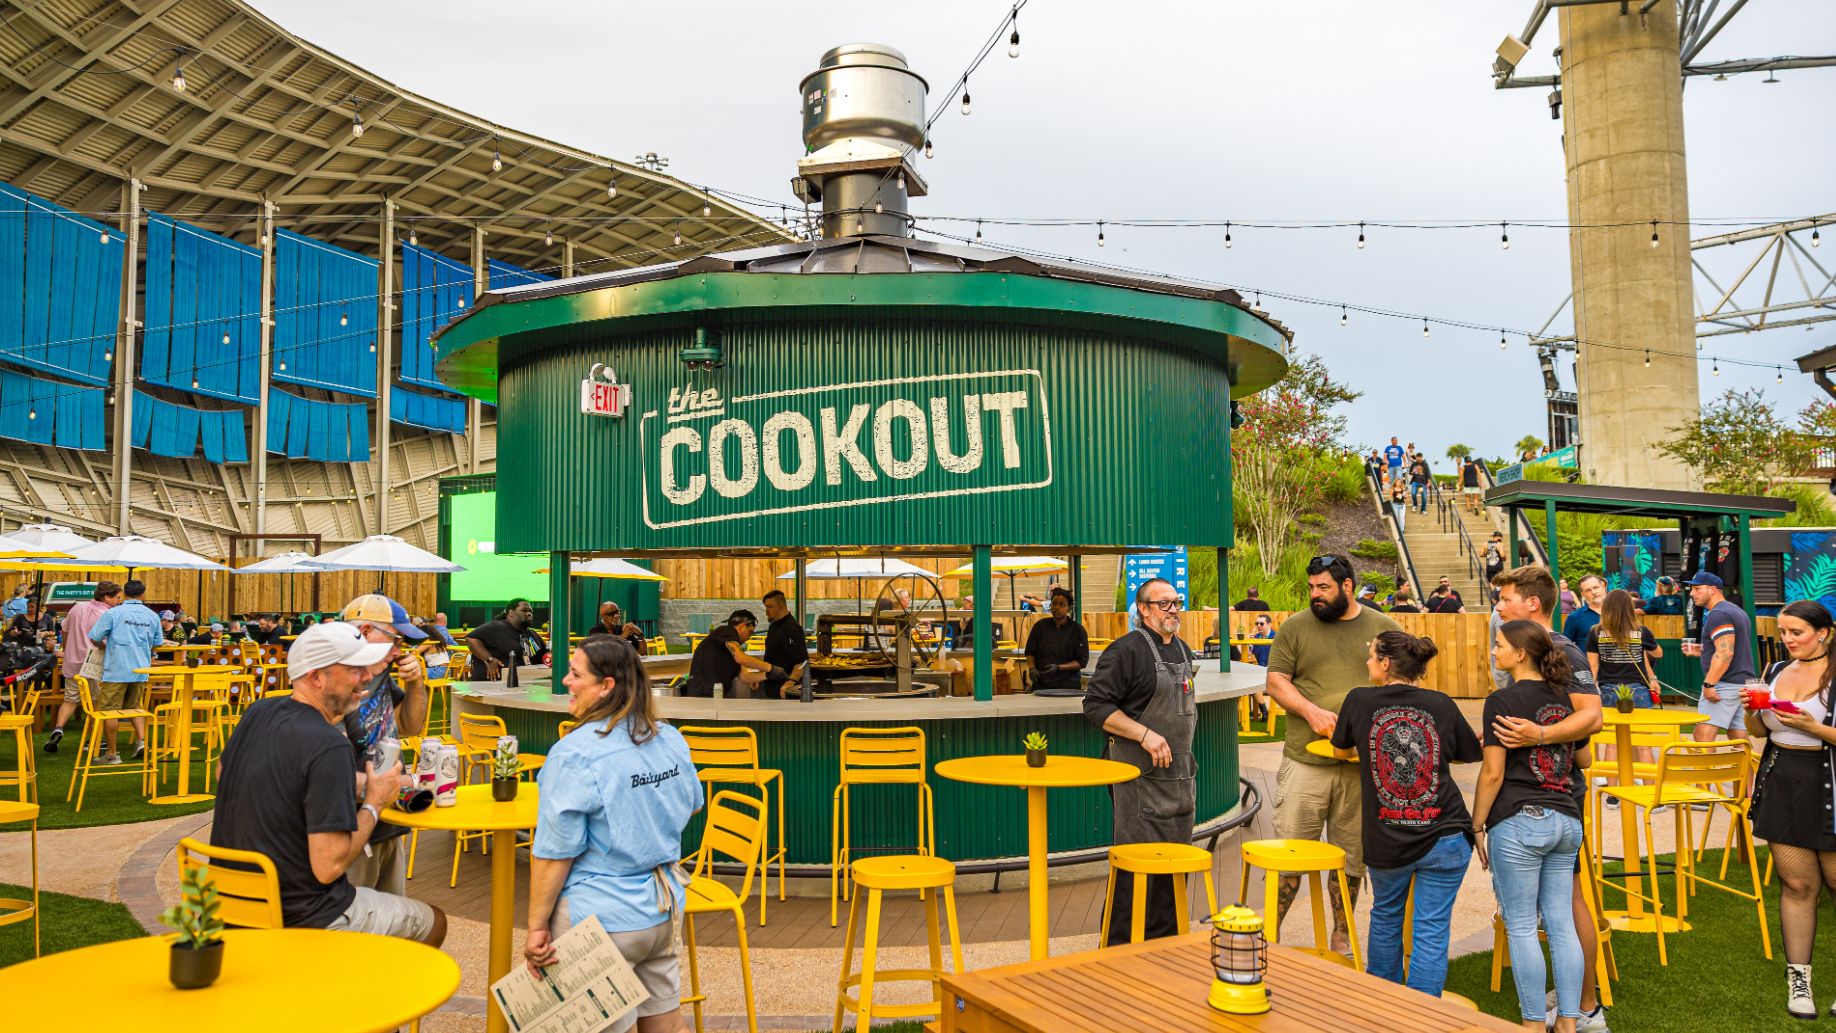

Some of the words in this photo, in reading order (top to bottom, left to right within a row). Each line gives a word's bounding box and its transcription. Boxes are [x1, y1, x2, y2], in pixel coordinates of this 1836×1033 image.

[595, 384, 619, 413] EXIT
[667, 382, 724, 414] the
[660, 390, 1028, 506] COOKOUT
[16, 668, 37, 682] RONIN
[630, 764, 680, 789] Backyard
